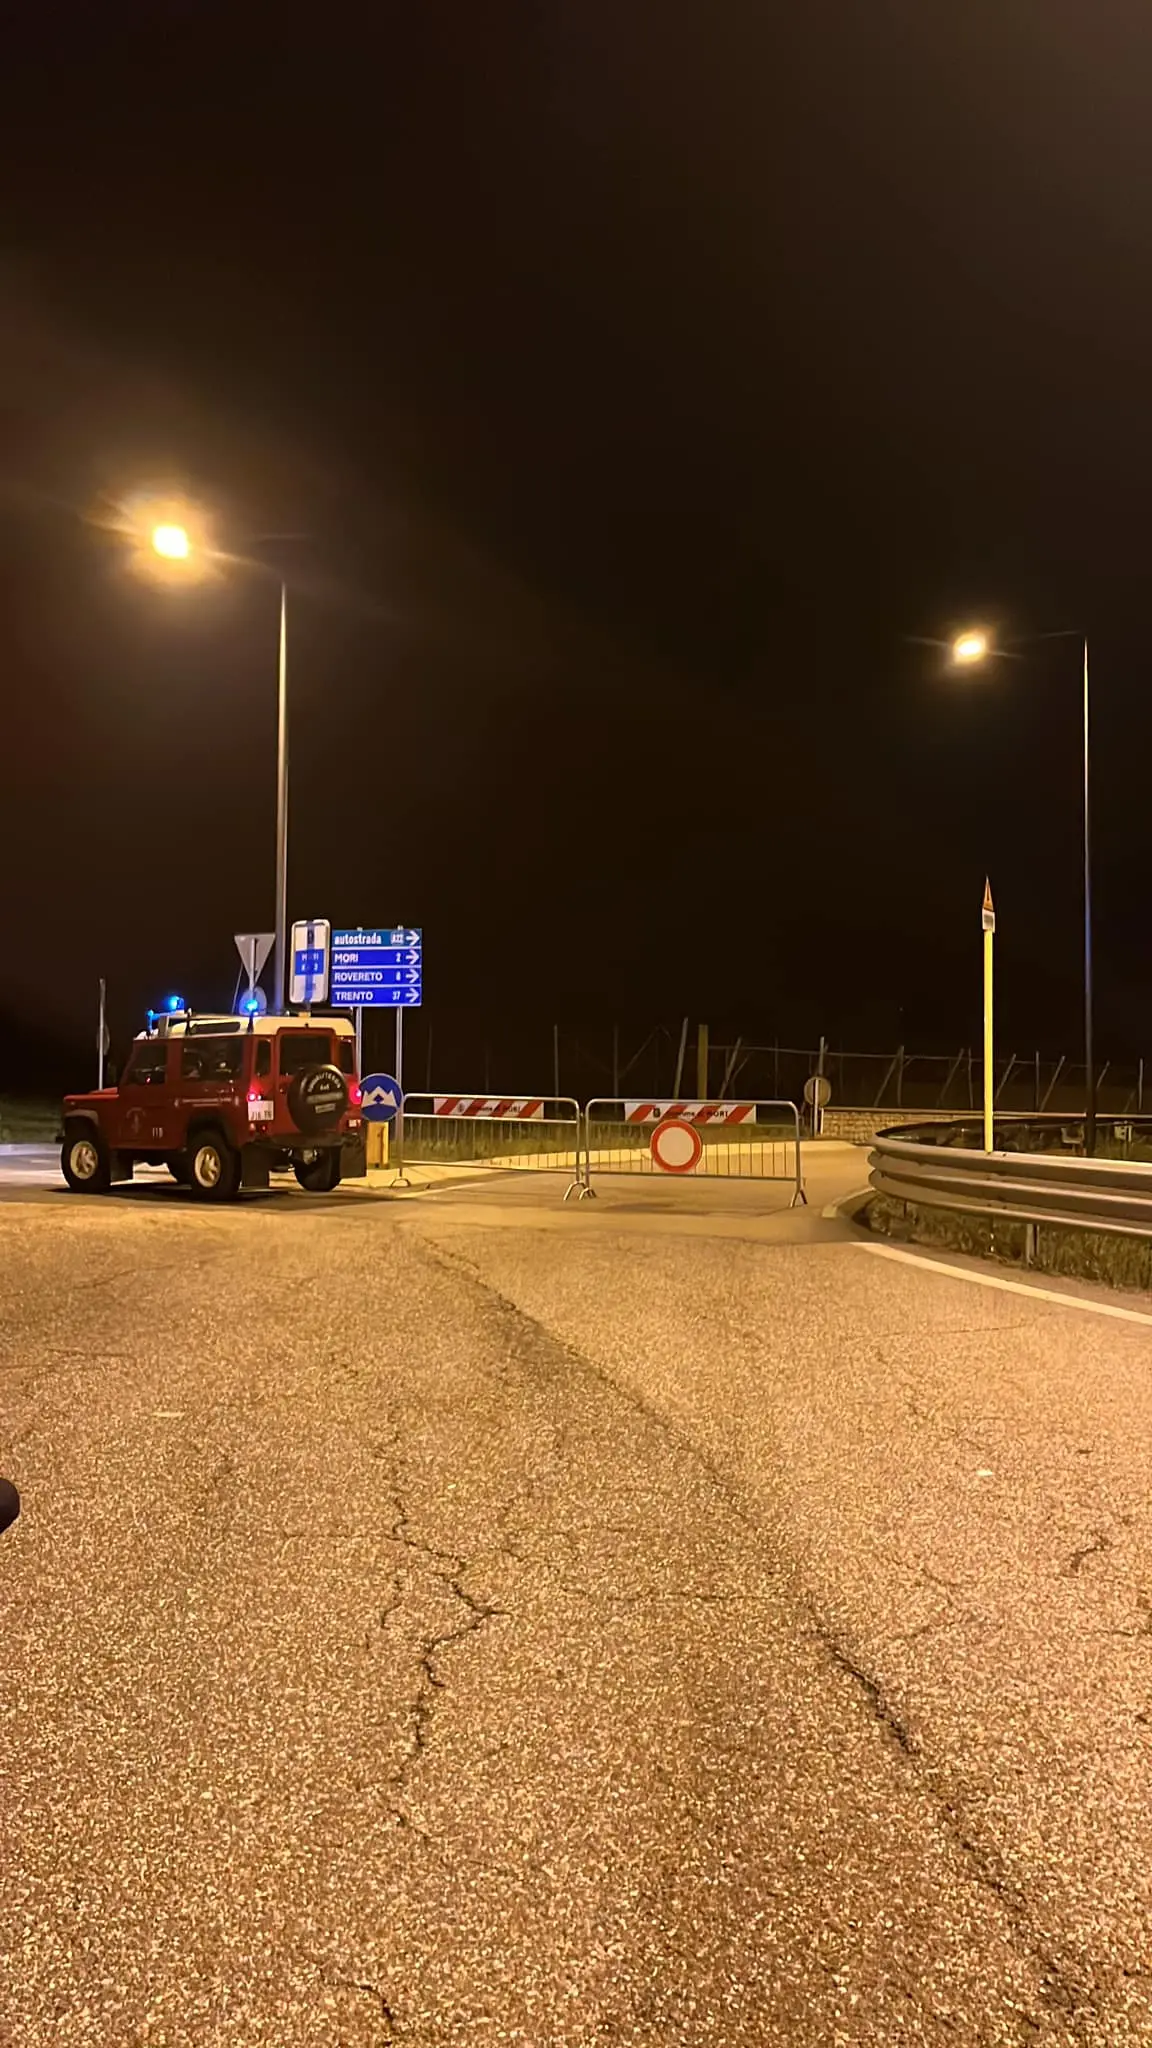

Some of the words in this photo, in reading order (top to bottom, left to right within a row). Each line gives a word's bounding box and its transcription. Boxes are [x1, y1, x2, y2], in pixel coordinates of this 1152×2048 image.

[334, 932, 382, 945] autostrada
[334, 952, 359, 963] MORI
[395, 952, 401, 963] 2
[334, 971, 383, 982] ROVERETO
[335, 991, 374, 1001] TRENTO
